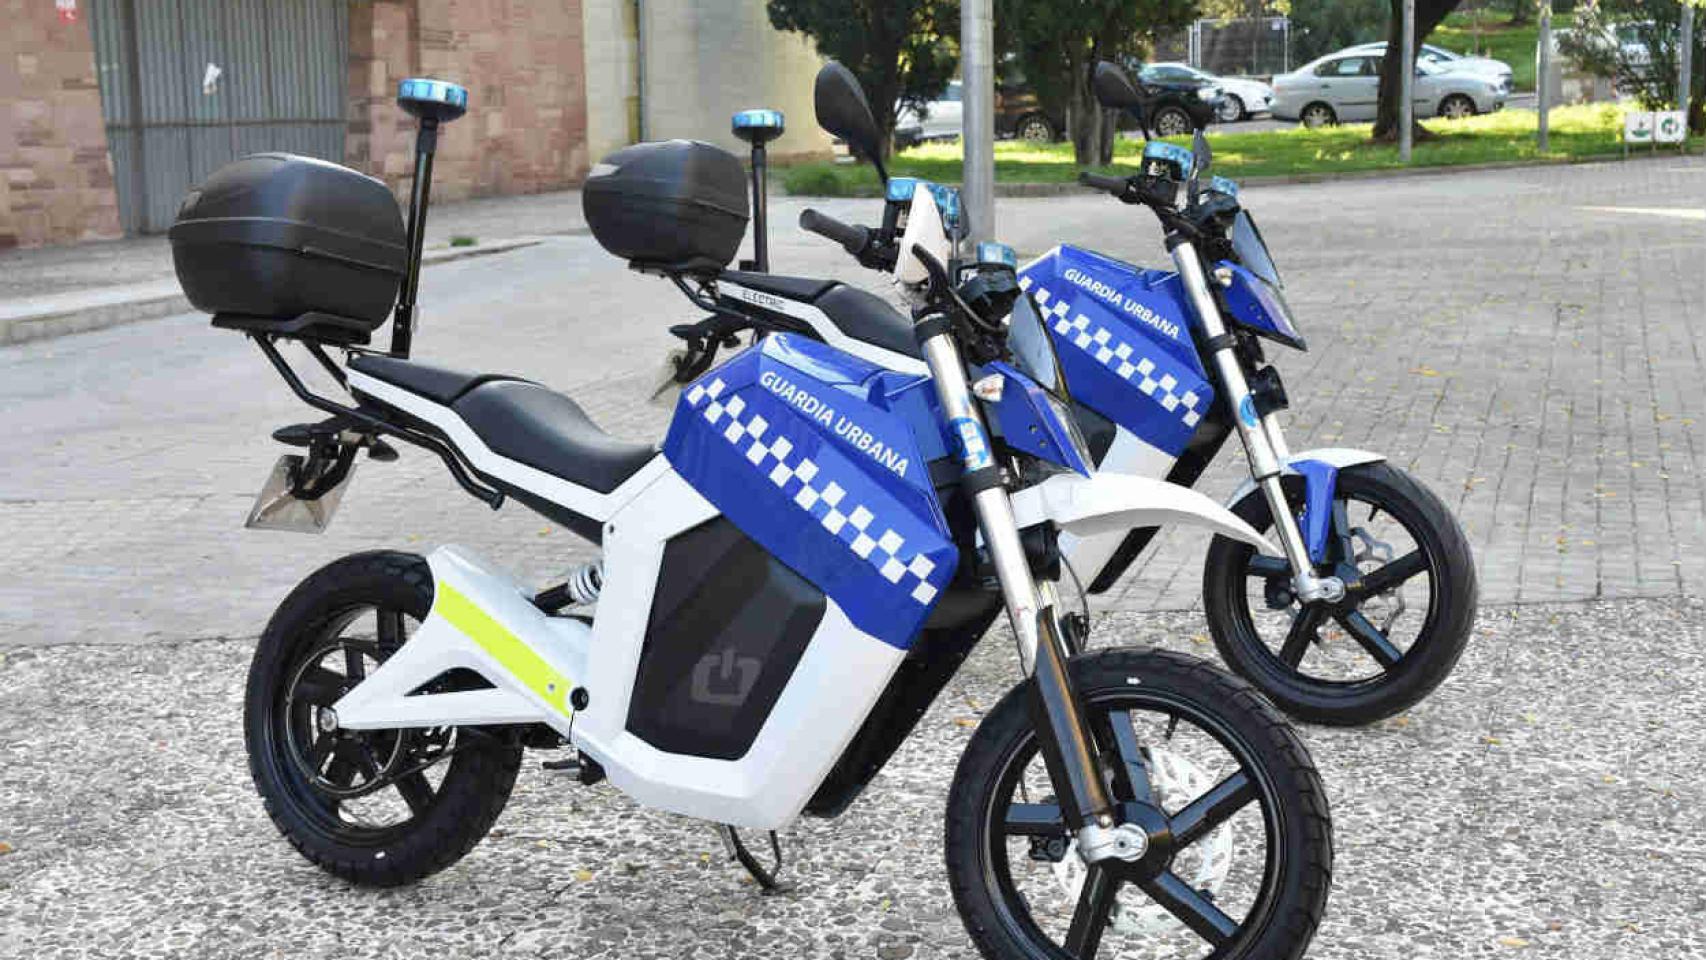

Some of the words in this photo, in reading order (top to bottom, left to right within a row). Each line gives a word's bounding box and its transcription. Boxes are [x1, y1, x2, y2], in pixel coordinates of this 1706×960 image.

[1064, 268, 1123, 304] GUARDIA
[1123, 299, 1180, 339] URBANA
[760, 371, 835, 427] GUARDIA
[834, 416, 909, 478] URBANA
